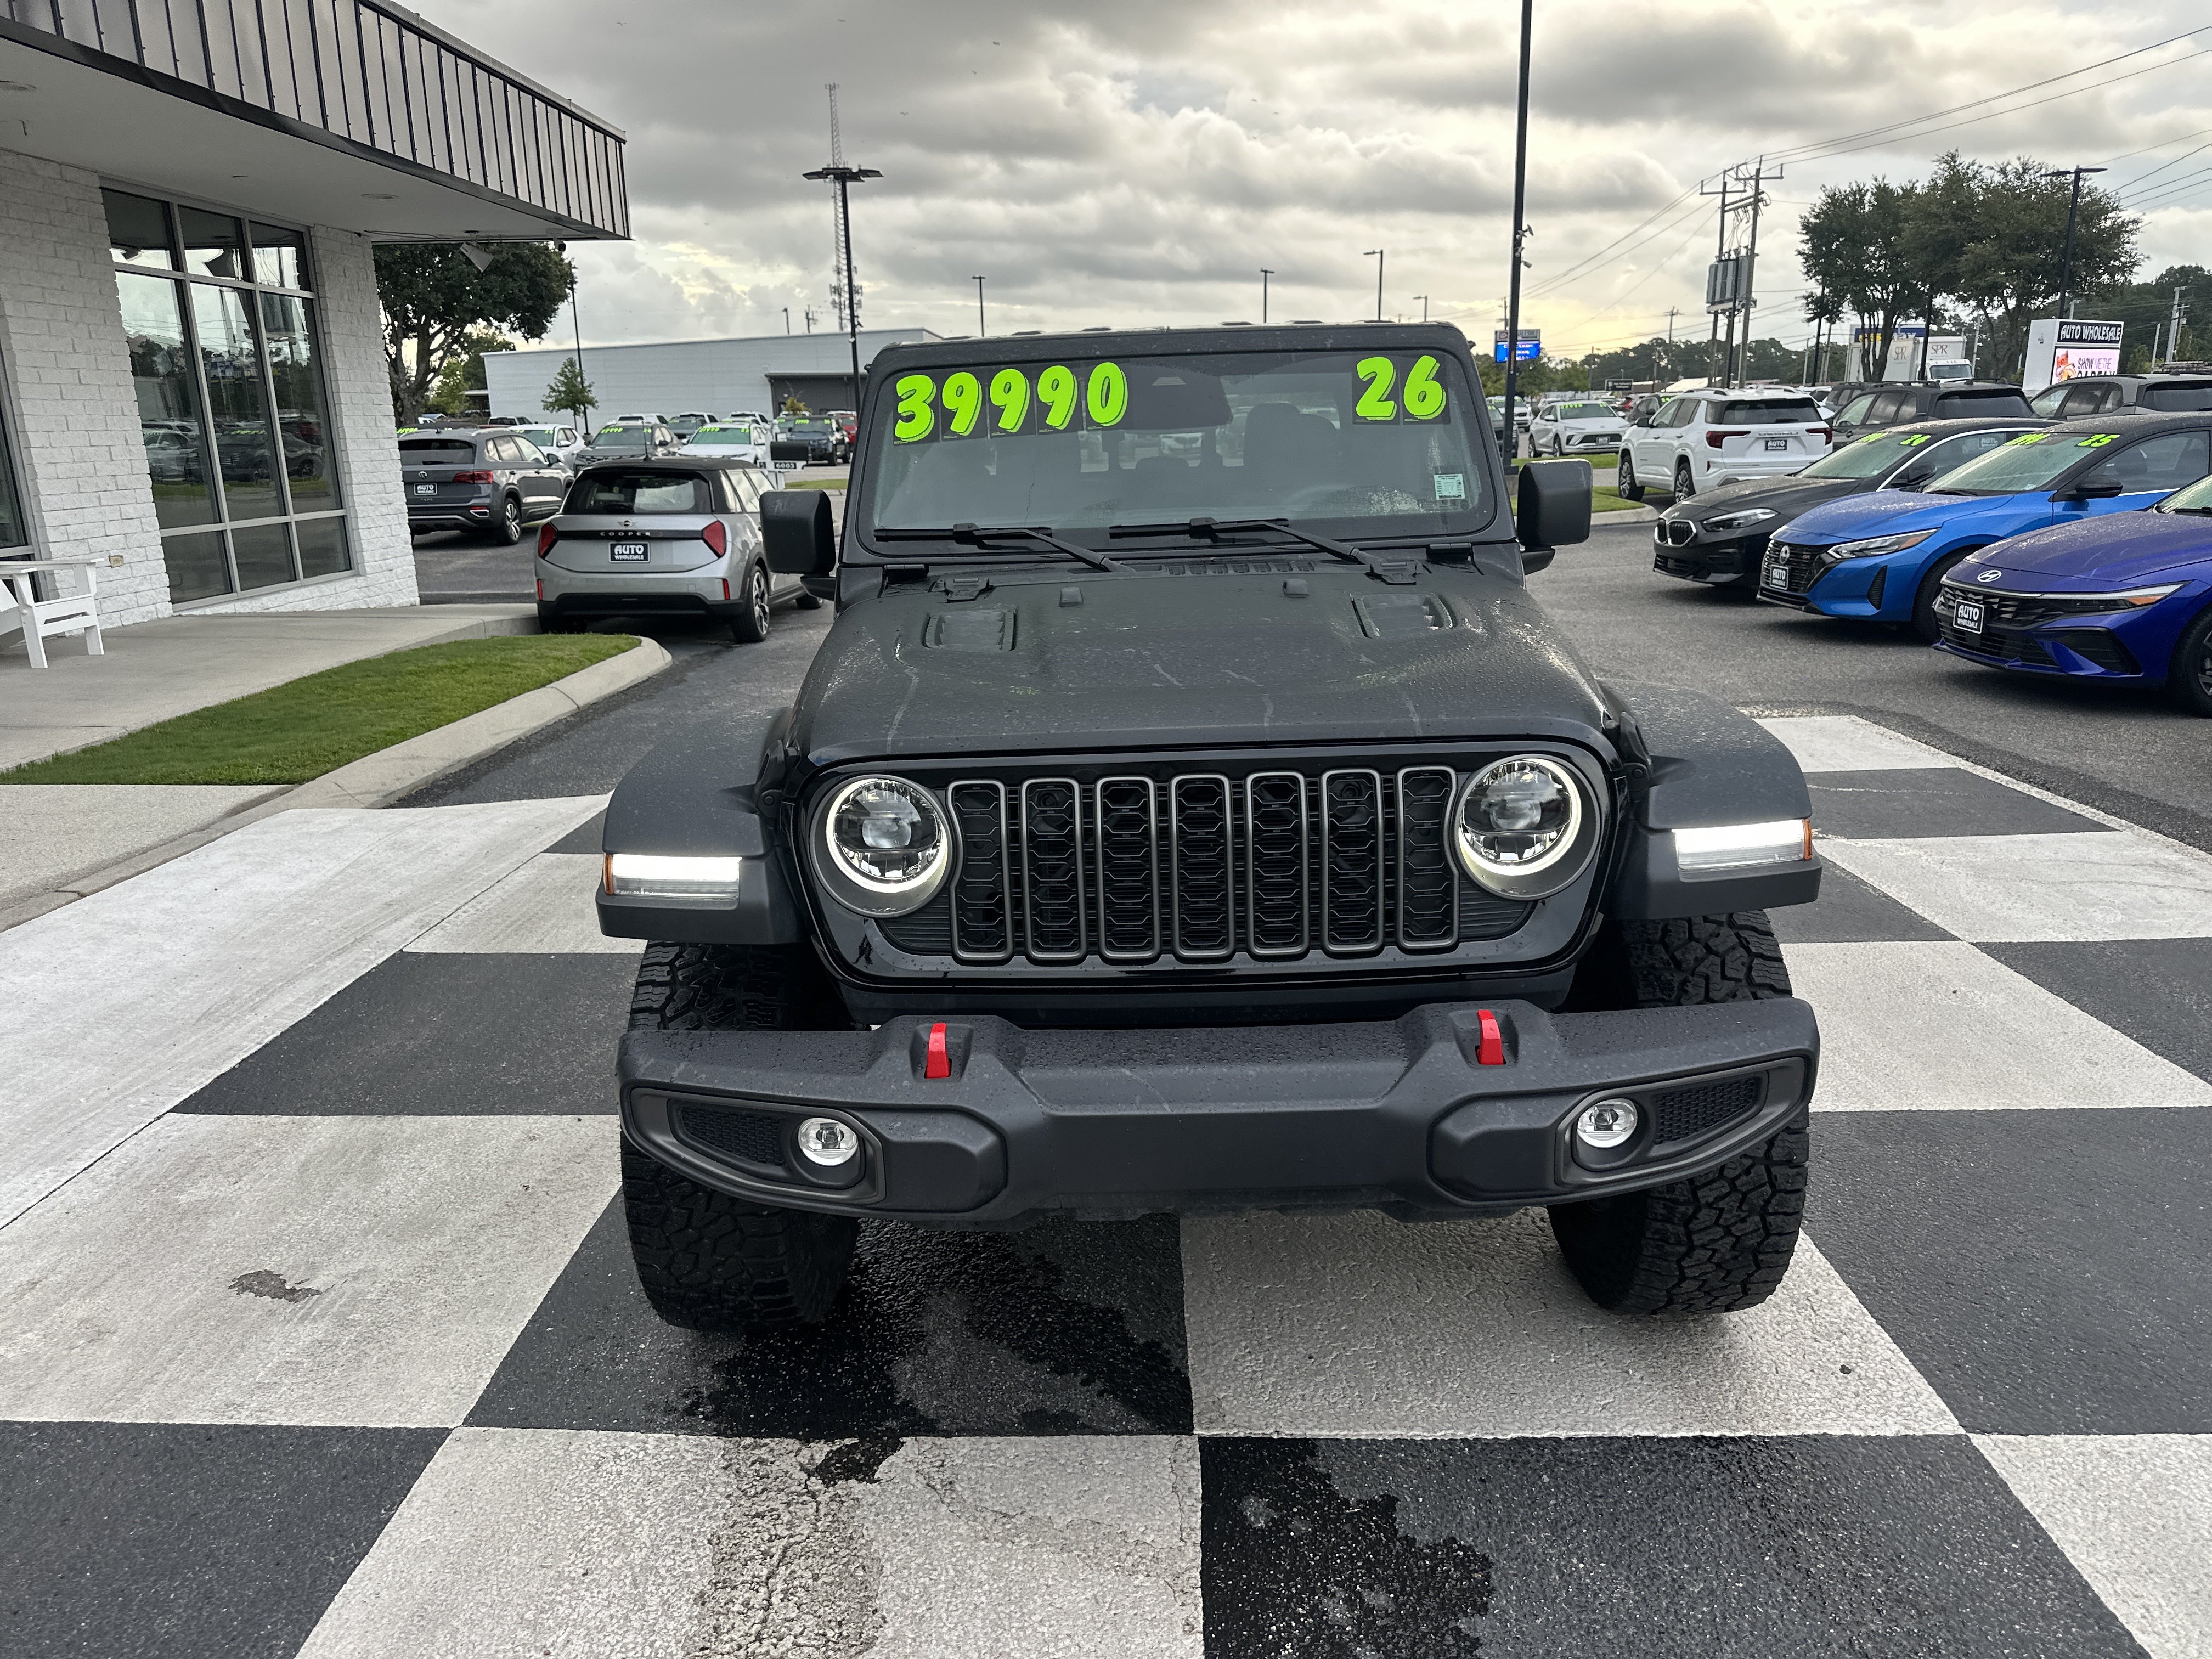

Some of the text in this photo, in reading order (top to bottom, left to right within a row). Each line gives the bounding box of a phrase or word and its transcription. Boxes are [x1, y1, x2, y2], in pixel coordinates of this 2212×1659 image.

[2060, 325, 2121, 341] AUTO WHOLESALE
[1894, 346, 1907, 360] SPR
[1931, 345, 1948, 354] SPR
[2078, 358, 2094, 369] SHOW
[894, 354, 1447, 442] 39990 26
[2077, 434, 2120, 447] 25
[614, 545, 644, 555] AUTO
[1772, 568, 1786, 580] AUTO
[1958, 605, 1979, 621] AUTO
